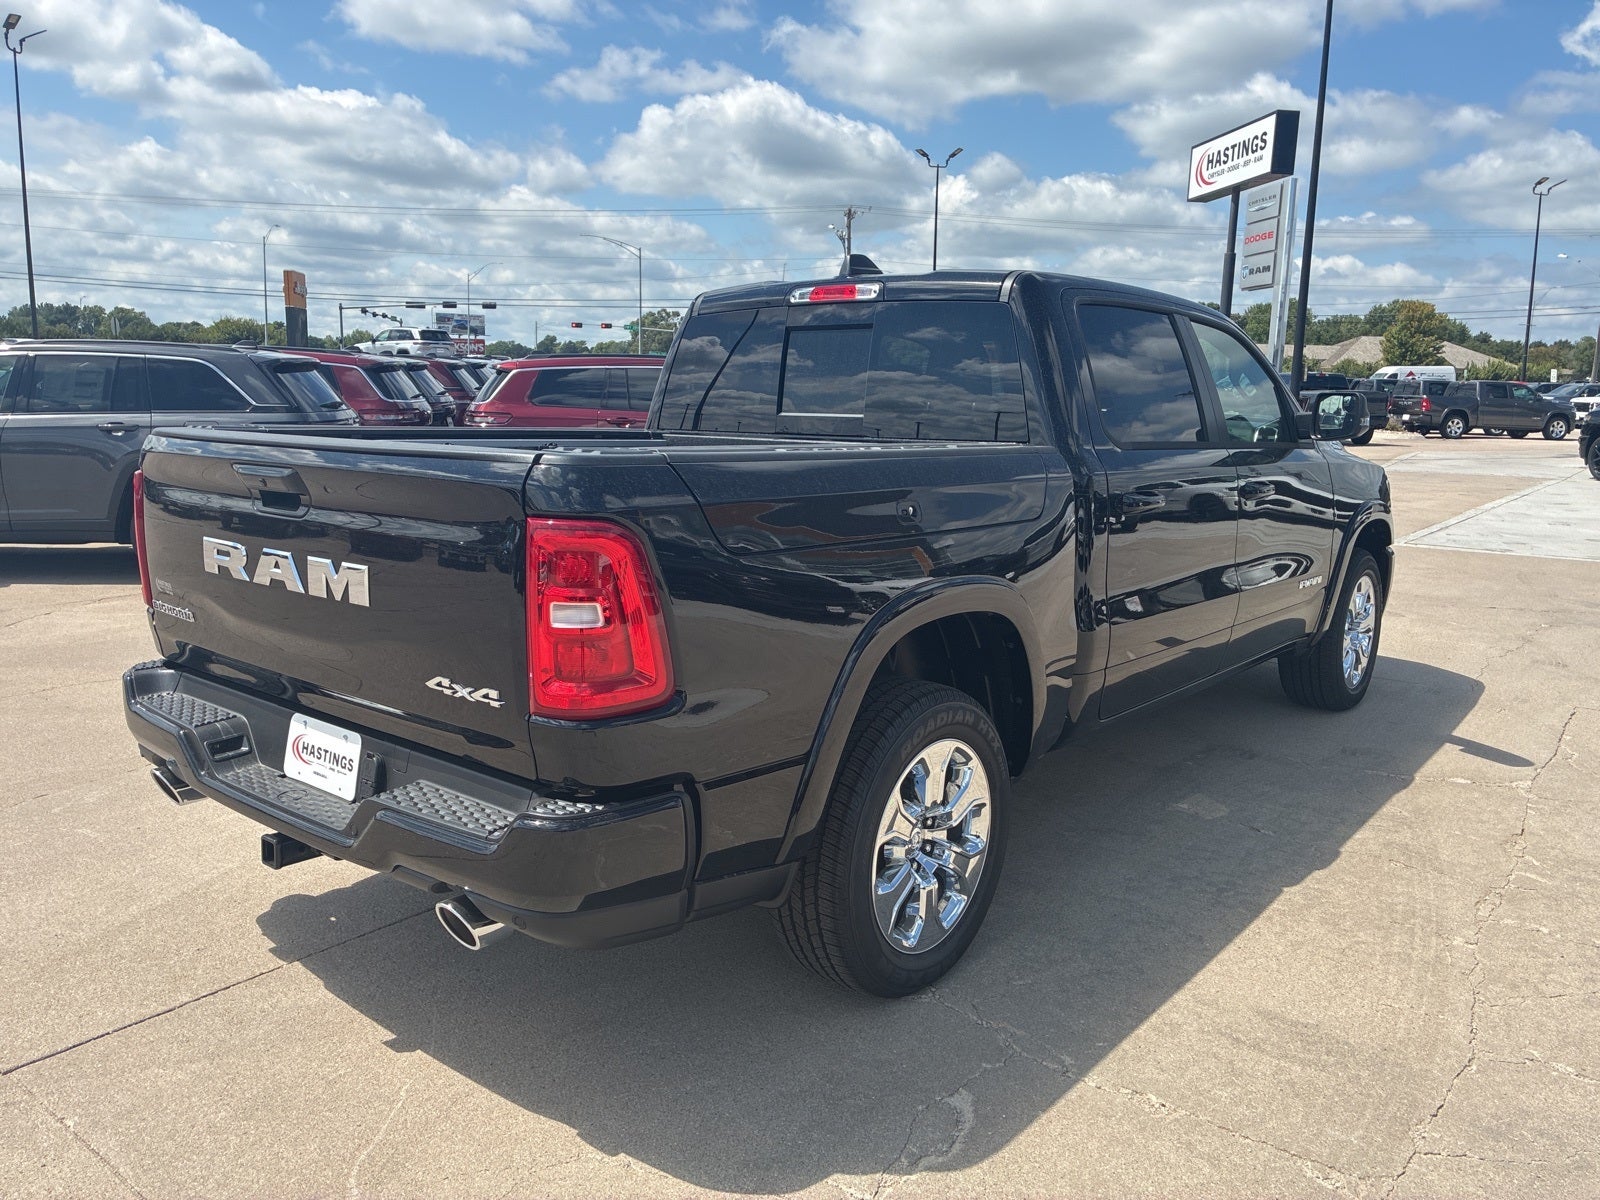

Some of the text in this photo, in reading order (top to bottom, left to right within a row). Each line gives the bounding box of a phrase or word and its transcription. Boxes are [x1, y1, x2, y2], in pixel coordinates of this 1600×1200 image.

[1206, 131, 1268, 171] HASTINGS
[1227, 162, 1241, 173] DODGE
[1248, 194, 1277, 207] CHRYSLER
[1244, 231, 1274, 245] DODGE
[1248, 264, 1271, 276] RAM
[203, 536, 370, 607] RAM
[901, 710, 975, 759] ROADIAN
[301, 741, 354, 772] HASTINGS
